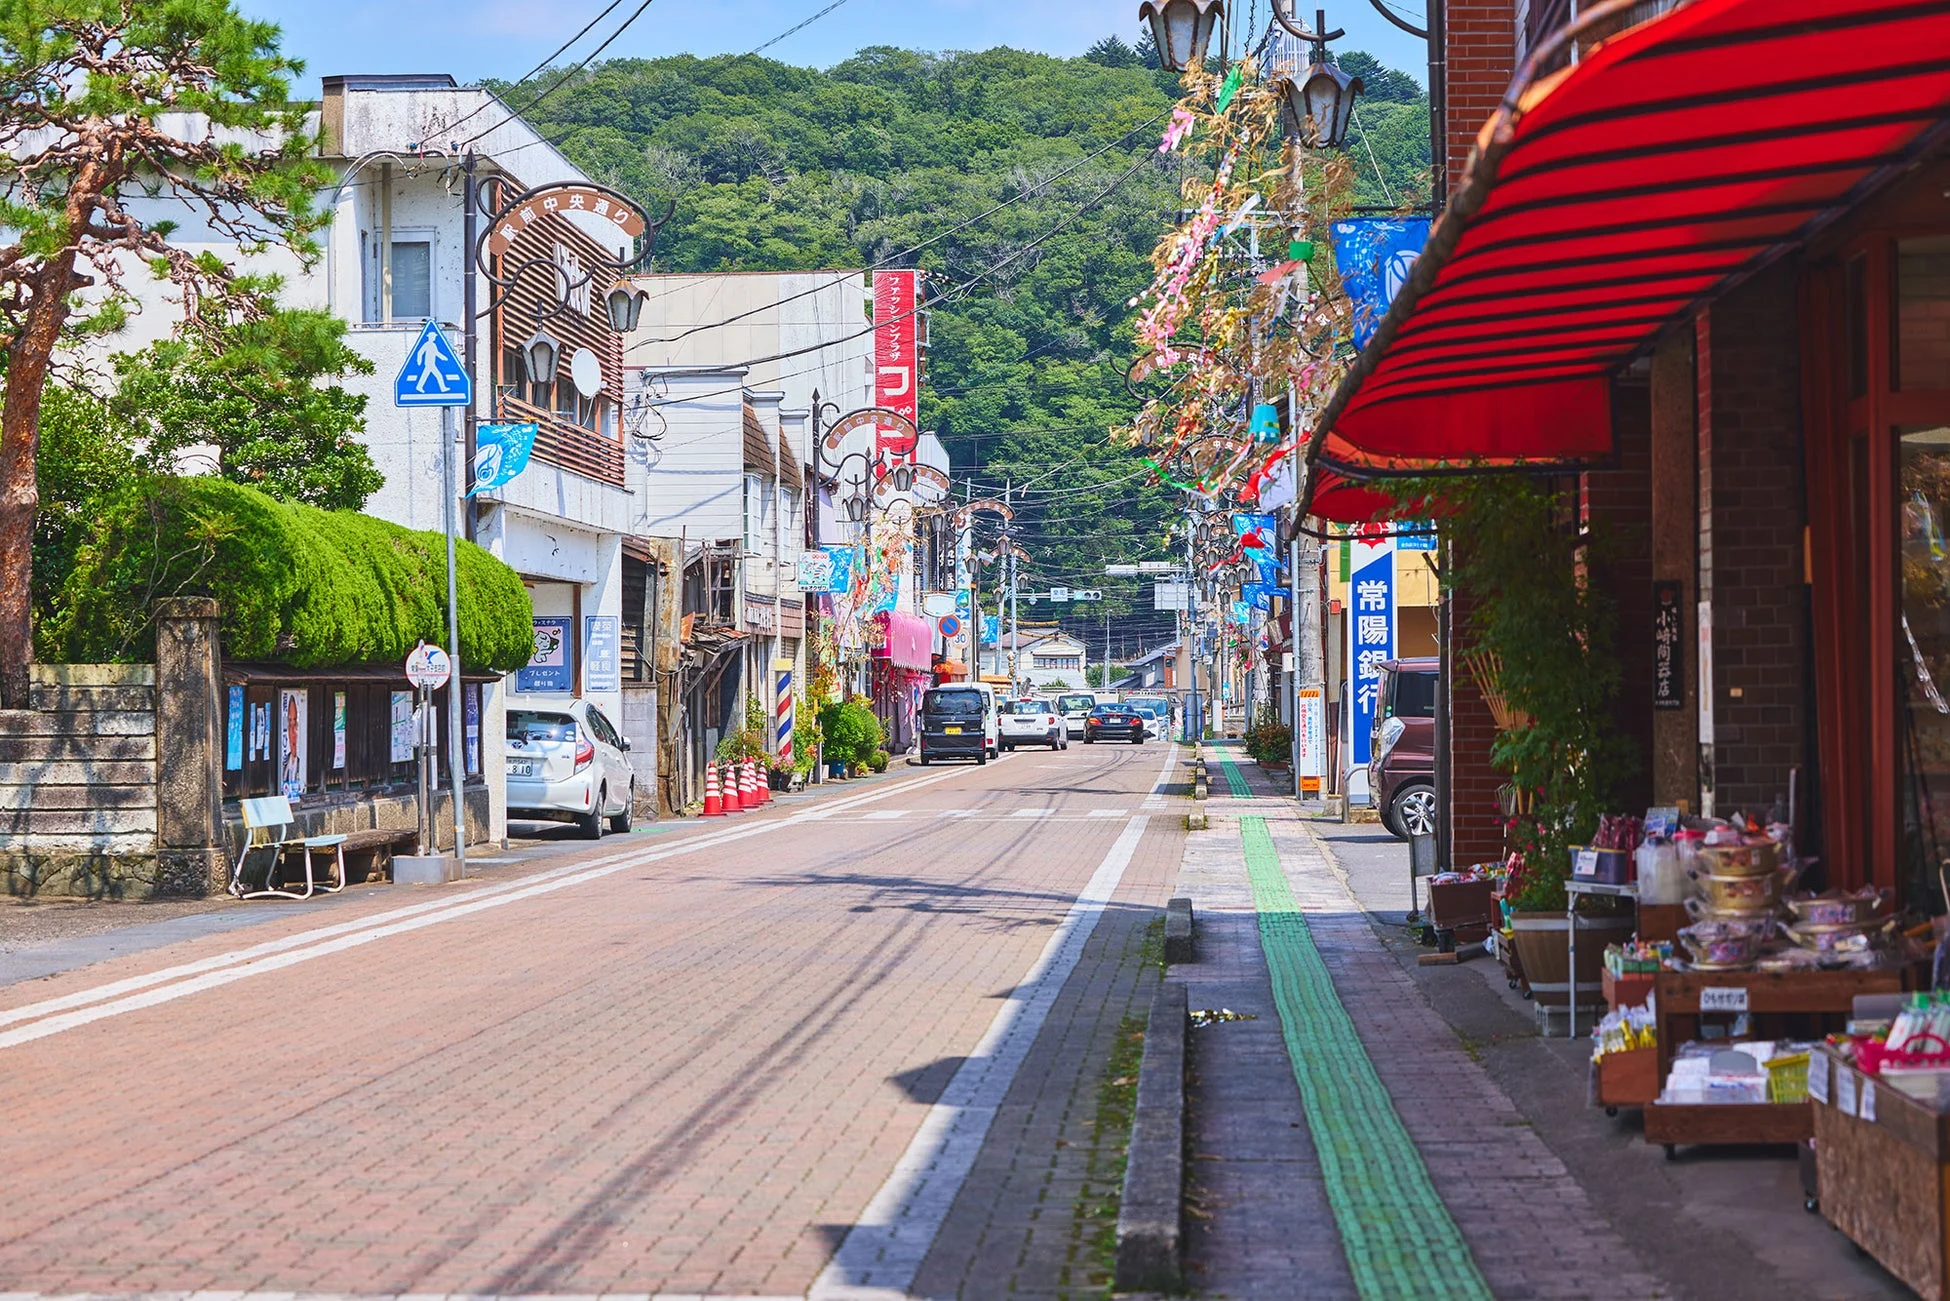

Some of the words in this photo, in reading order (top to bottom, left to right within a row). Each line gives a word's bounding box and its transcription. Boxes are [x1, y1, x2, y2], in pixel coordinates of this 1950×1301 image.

[500, 193, 629, 242] 駅前中央通り
[955, 634, 966, 643] 30
[1357, 580, 1388, 714] 常陽銀行
